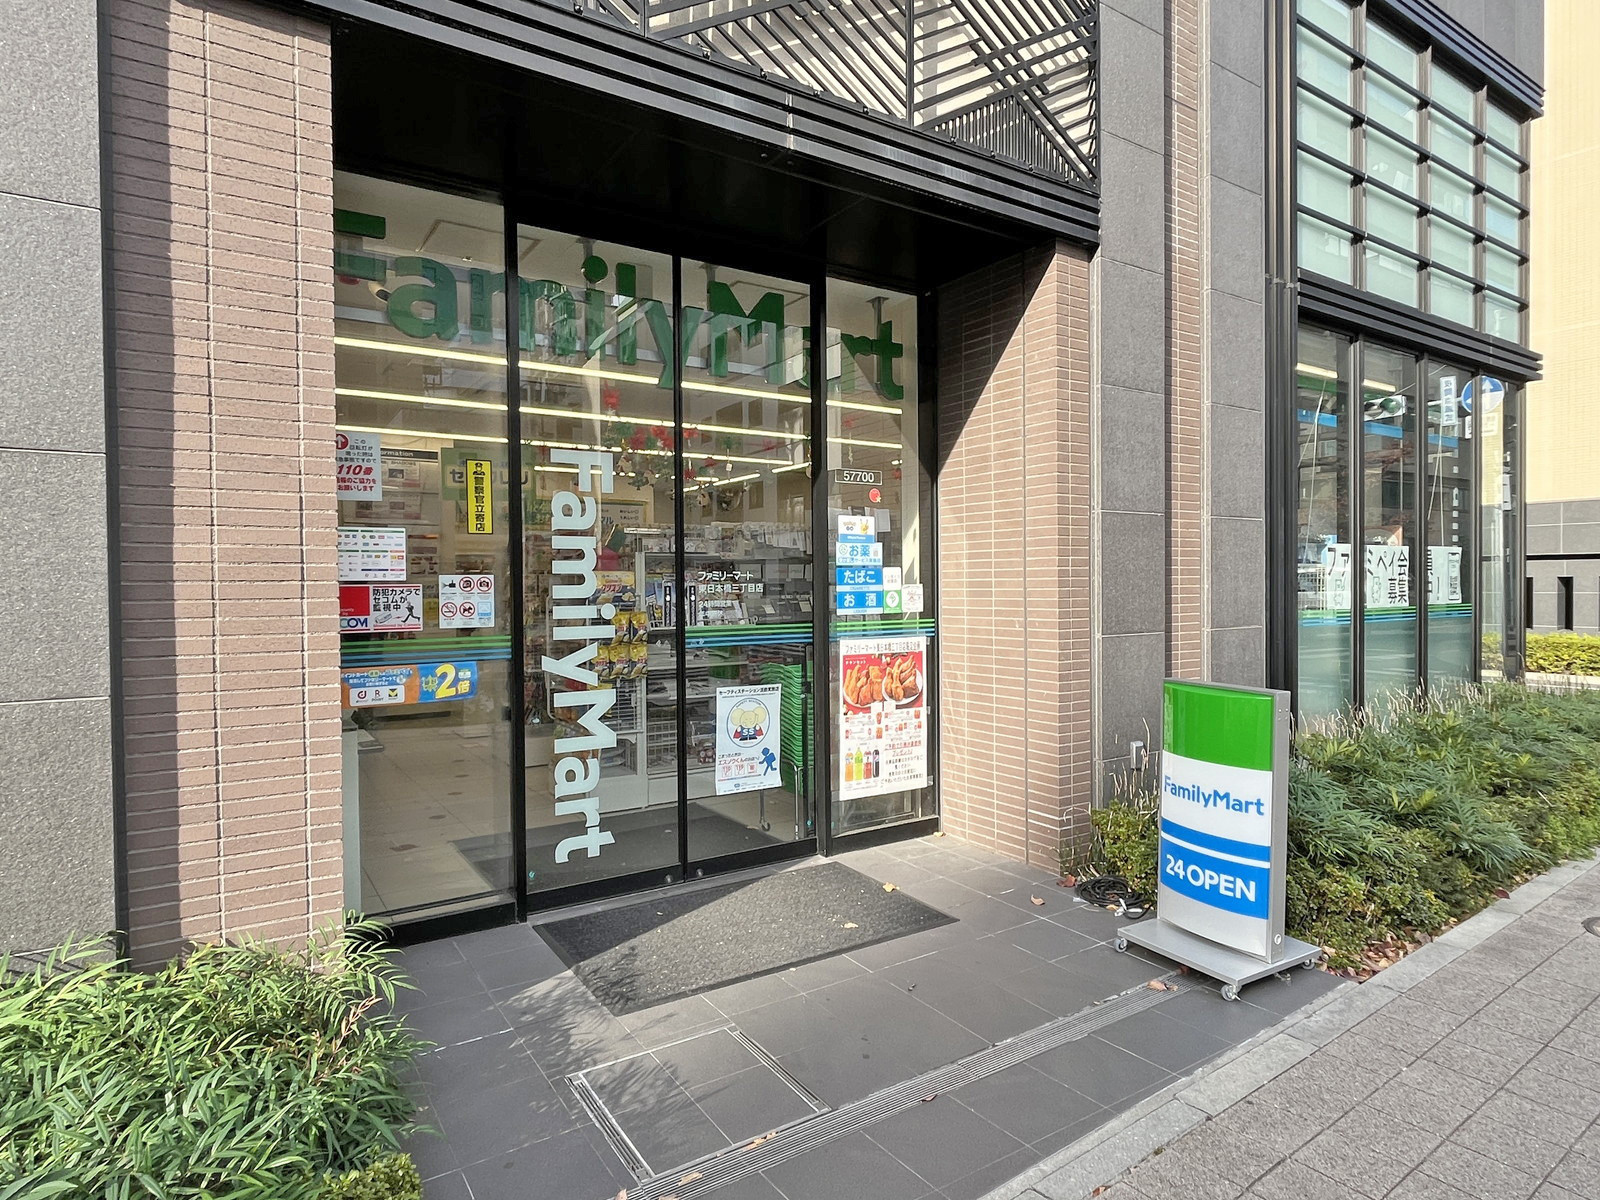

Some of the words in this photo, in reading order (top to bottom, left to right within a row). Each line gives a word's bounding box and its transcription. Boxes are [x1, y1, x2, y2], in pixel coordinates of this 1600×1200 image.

[337, 464, 374, 476] 110番
[843, 471, 875, 483] 57700
[473, 476, 486, 532] 警察官立寄店
[849, 544, 870, 557] お薬
[697, 570, 754, 581] ファミリーマート
[843, 570, 876, 584] たばこ
[372, 588, 420, 597] 防犯カメラで
[698, 583, 764, 594] 東日本橋三丁目店
[373, 596, 407, 604] セコムが
[373, 603, 401, 612] 監視中
[339, 617, 368, 628] COM
[541, 451, 617, 864] FamilyMart
[742, 728, 755, 737] SS
[1164, 775, 1265, 817] FamilyMart
